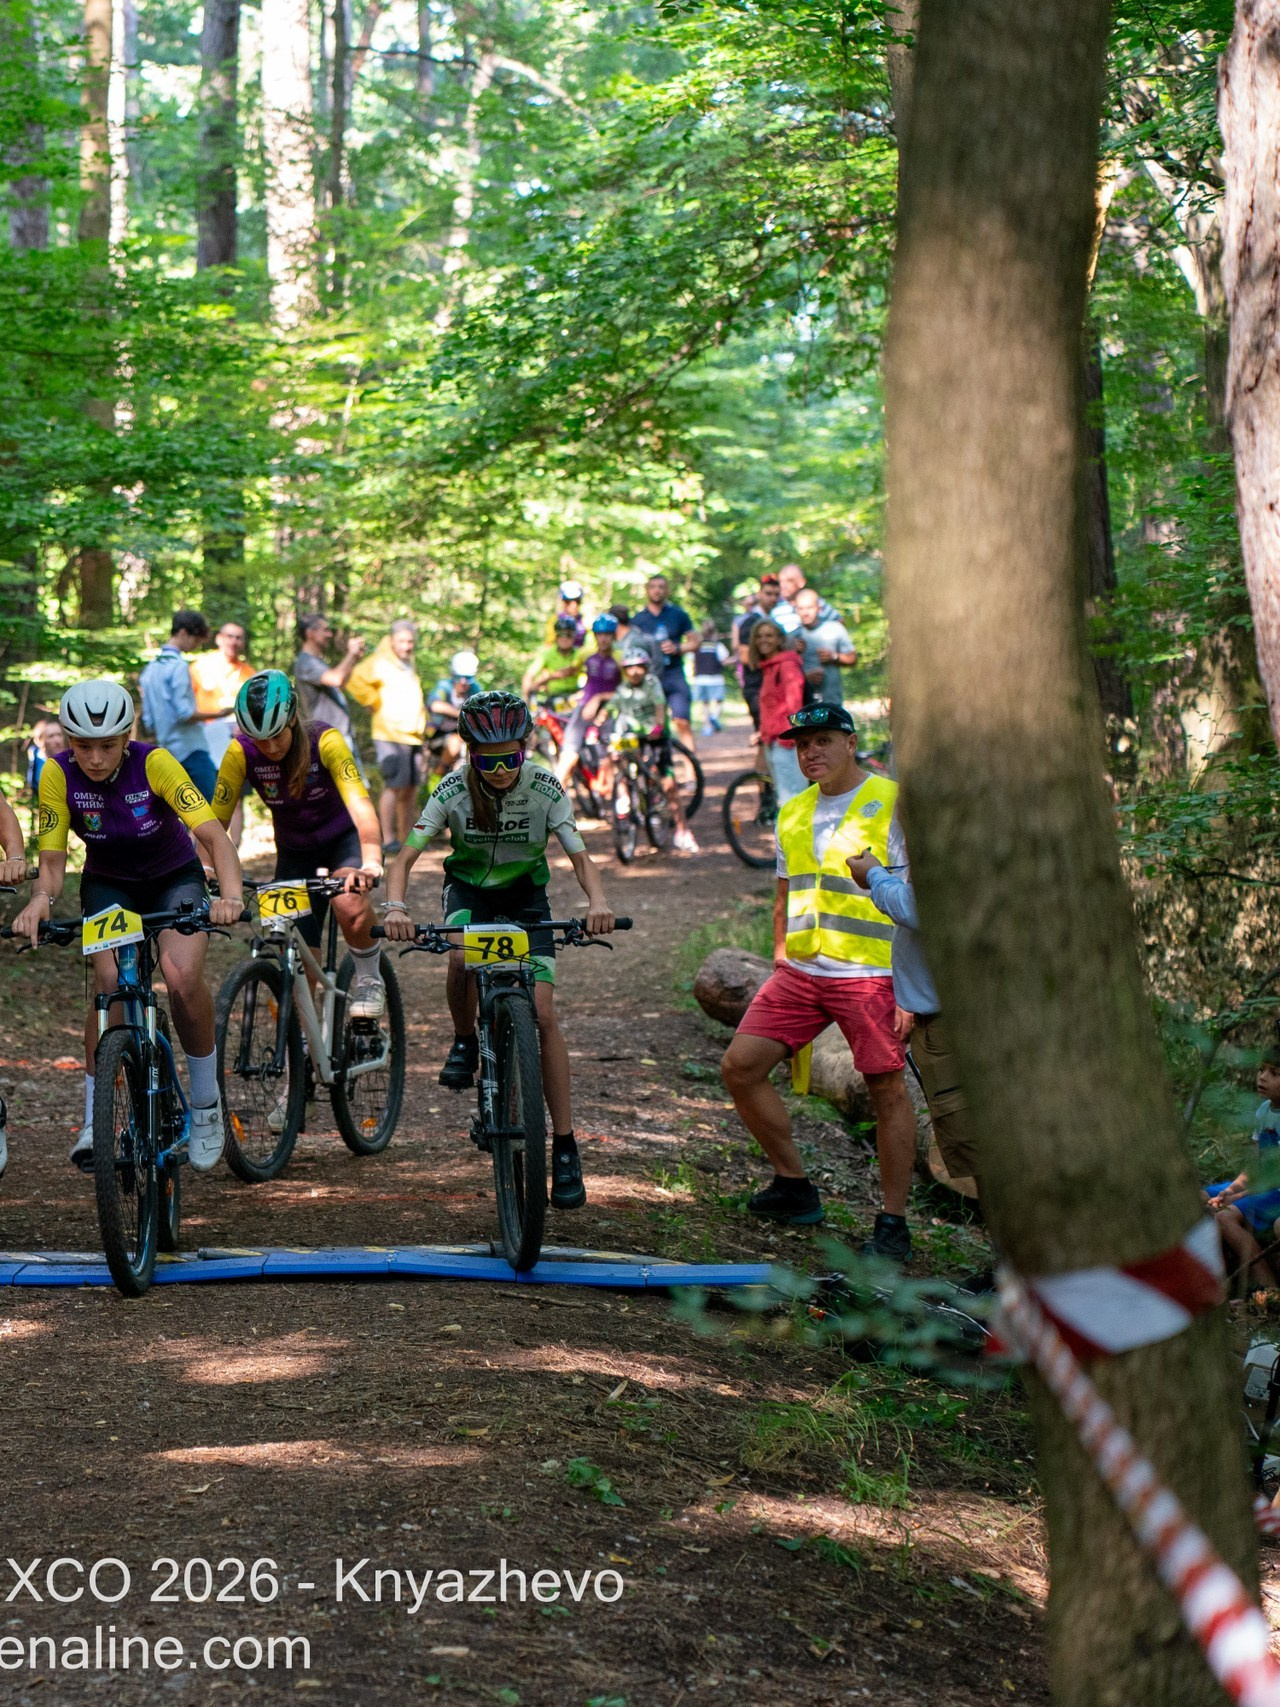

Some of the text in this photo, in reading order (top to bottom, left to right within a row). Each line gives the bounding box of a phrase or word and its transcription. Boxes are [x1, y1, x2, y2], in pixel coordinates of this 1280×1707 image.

[432, 775, 463, 798] BEROE
[534, 772, 566, 797] BEROE
[535, 783, 558, 799] ROAD
[75, 800, 105, 809] ТИЙМ
[466, 817, 530, 832] BROE
[268, 891, 297, 913] 76
[93, 911, 129, 940] 74
[477, 936, 514, 960] 78
